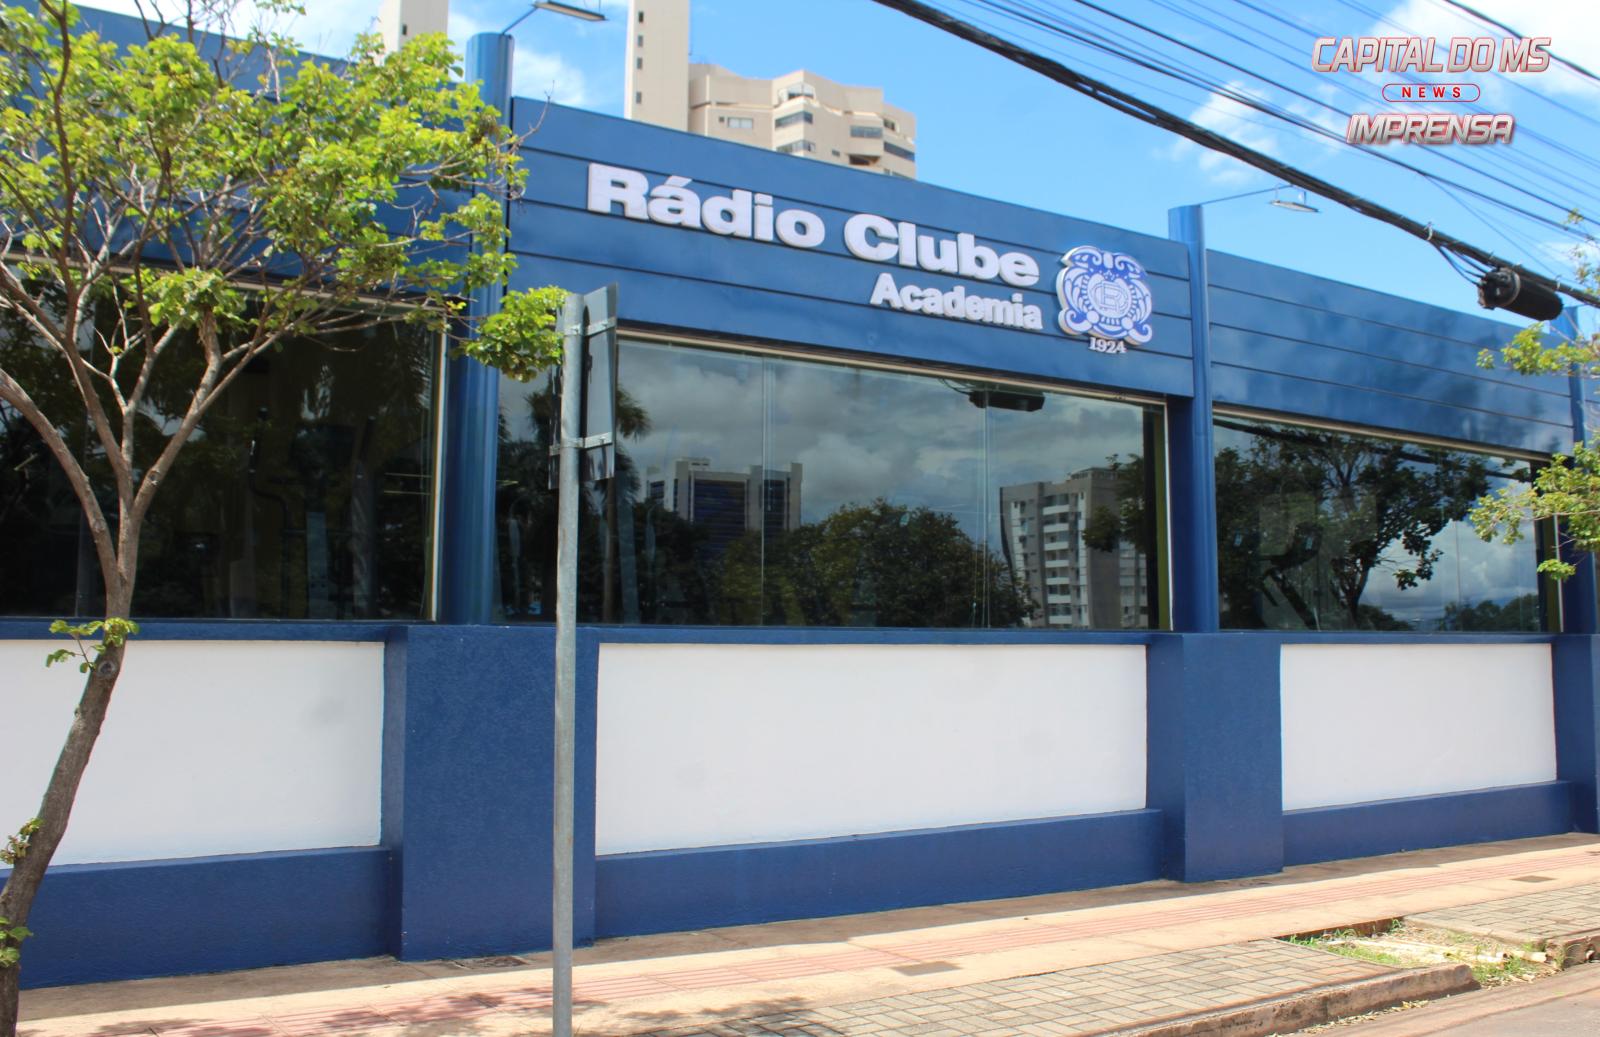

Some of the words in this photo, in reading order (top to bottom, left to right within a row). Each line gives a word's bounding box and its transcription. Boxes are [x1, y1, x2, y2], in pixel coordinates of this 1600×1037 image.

[587, 162, 826, 248] Rádio
[844, 213, 1040, 286] Clube
[870, 272, 1043, 330] Academia
[1089, 337, 1127, 354] 1924
